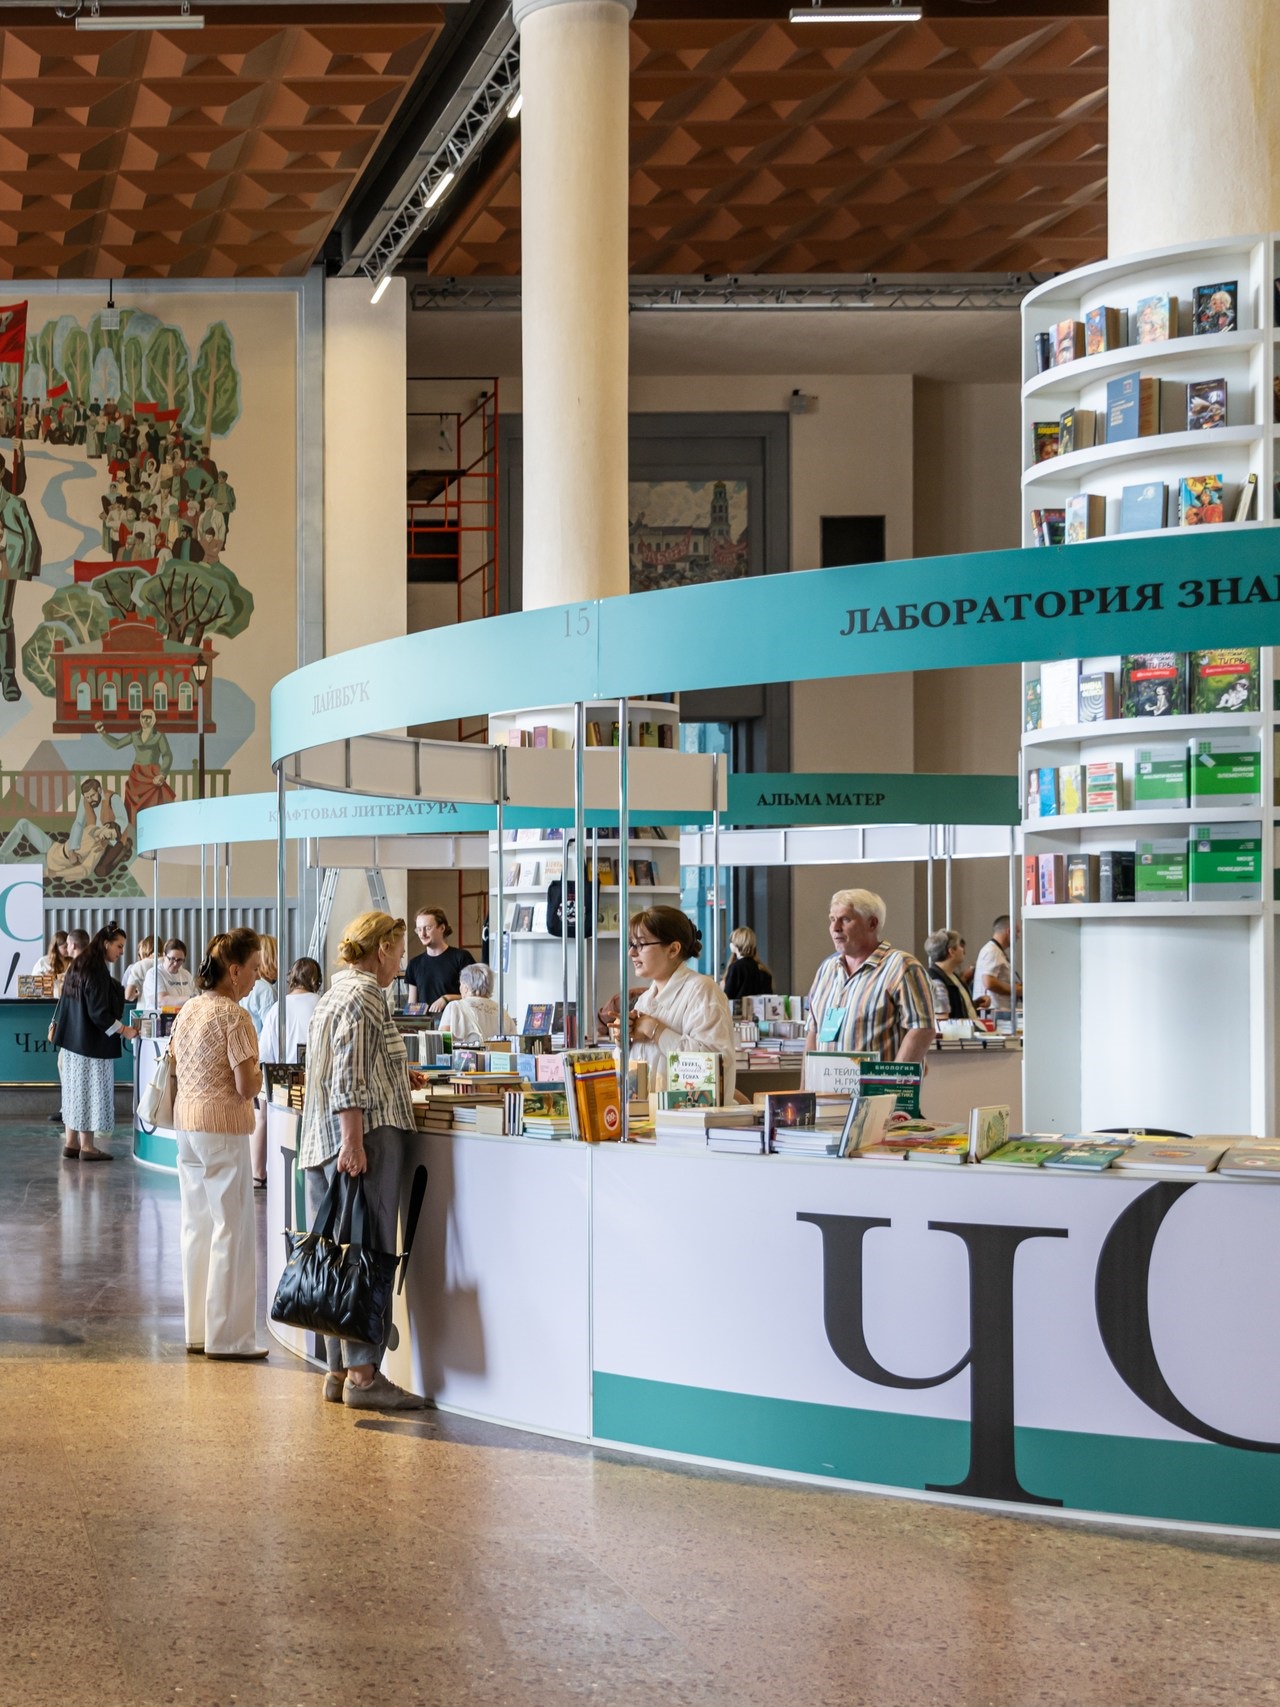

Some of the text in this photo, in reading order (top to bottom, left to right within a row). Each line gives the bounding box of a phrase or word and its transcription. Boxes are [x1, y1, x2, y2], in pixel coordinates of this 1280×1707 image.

[564, 608, 590, 637] 15
[840, 582, 1164, 636] ЛАБОРАТОРИЯ
[312, 680, 370, 715] ЛАЙВБУК
[268, 802, 458, 822] КАФТОВАЯ ЛИТЕРАТУРА
[757, 793, 885, 806] АЛЬМА МАТЕР
